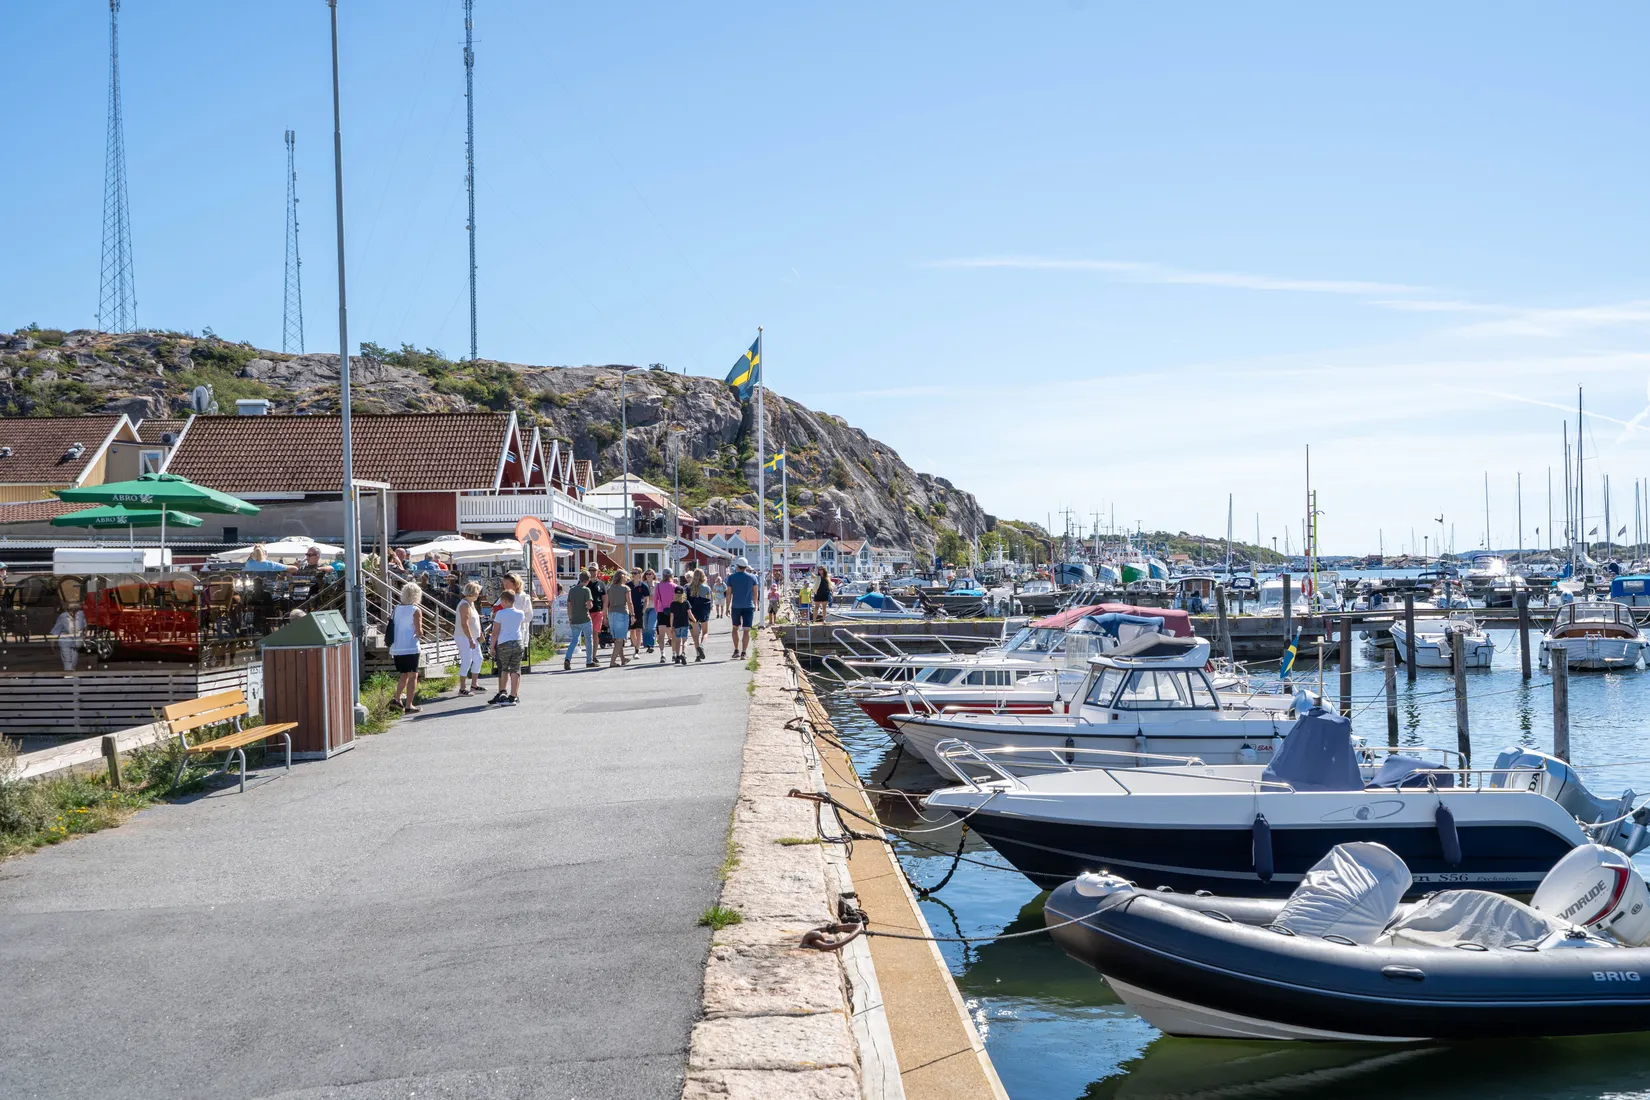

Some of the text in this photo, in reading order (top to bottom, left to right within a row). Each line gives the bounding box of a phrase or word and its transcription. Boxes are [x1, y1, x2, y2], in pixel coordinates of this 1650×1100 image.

[1438, 873, 1469, 882] S56
[1556, 880, 1607, 920] VINRUDE
[1591, 971, 1641, 982] BRIG
